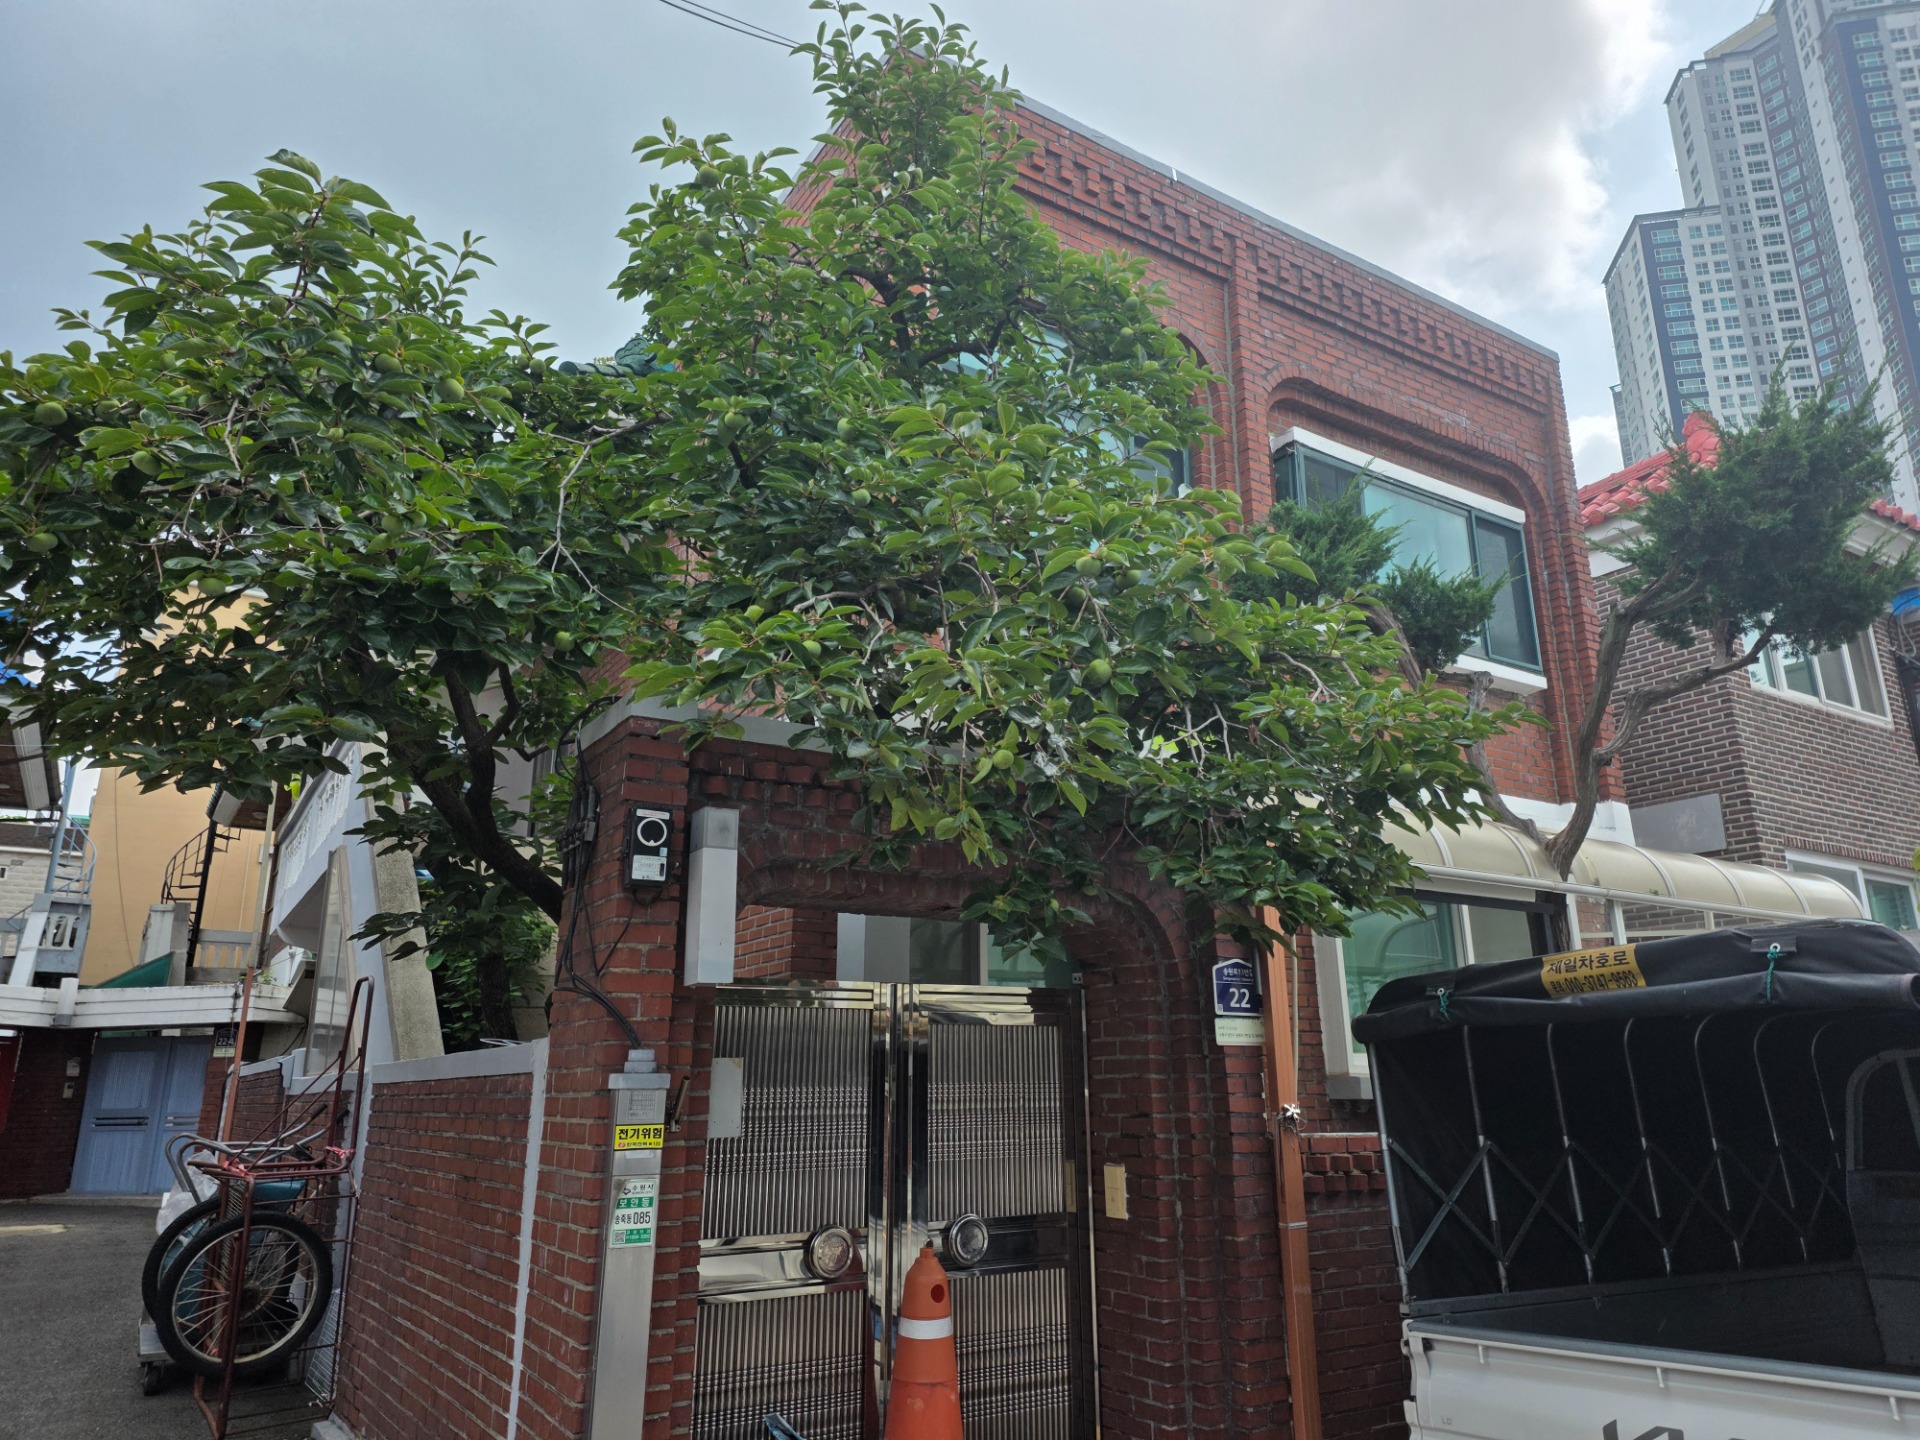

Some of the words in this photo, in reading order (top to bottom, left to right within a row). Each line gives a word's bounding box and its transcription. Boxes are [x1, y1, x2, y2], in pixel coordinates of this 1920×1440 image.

[1229, 987, 1251, 1008] 22
[618, 1127, 662, 1140] 전기위험
[619, 1198, 650, 1208] 보안등
[633, 1211, 651, 1225] 085
